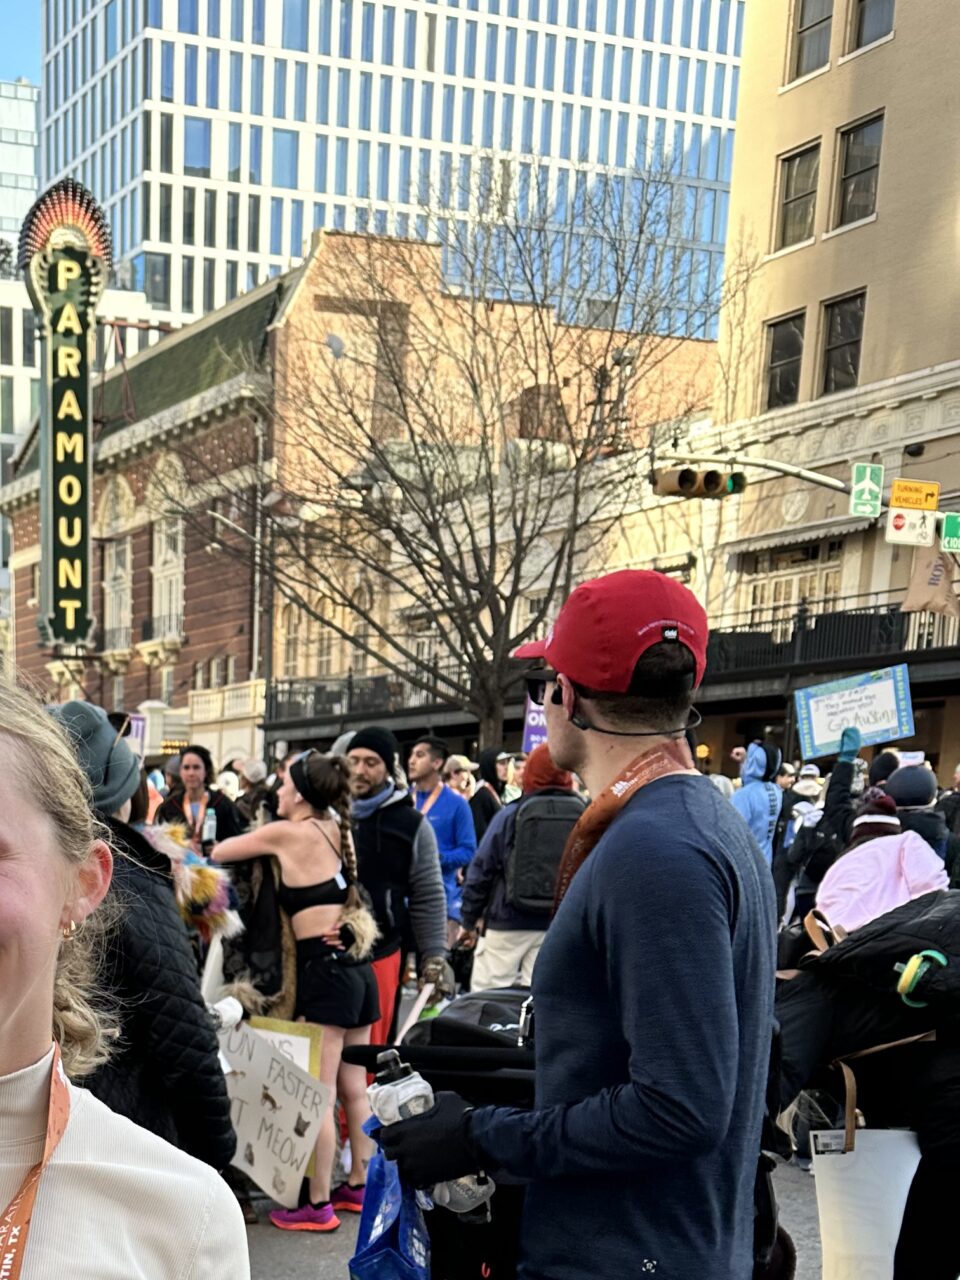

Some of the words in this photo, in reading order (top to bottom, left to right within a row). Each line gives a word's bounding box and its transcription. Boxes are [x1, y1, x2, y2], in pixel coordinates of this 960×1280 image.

[56, 259, 85, 631] PARAMOUNT
[222, 1028, 257, 1063] UN
[267, 1057, 324, 1119] FASTER
[256, 1116, 308, 1173] MEOW
[8, 1225, 22, 1246] TX
